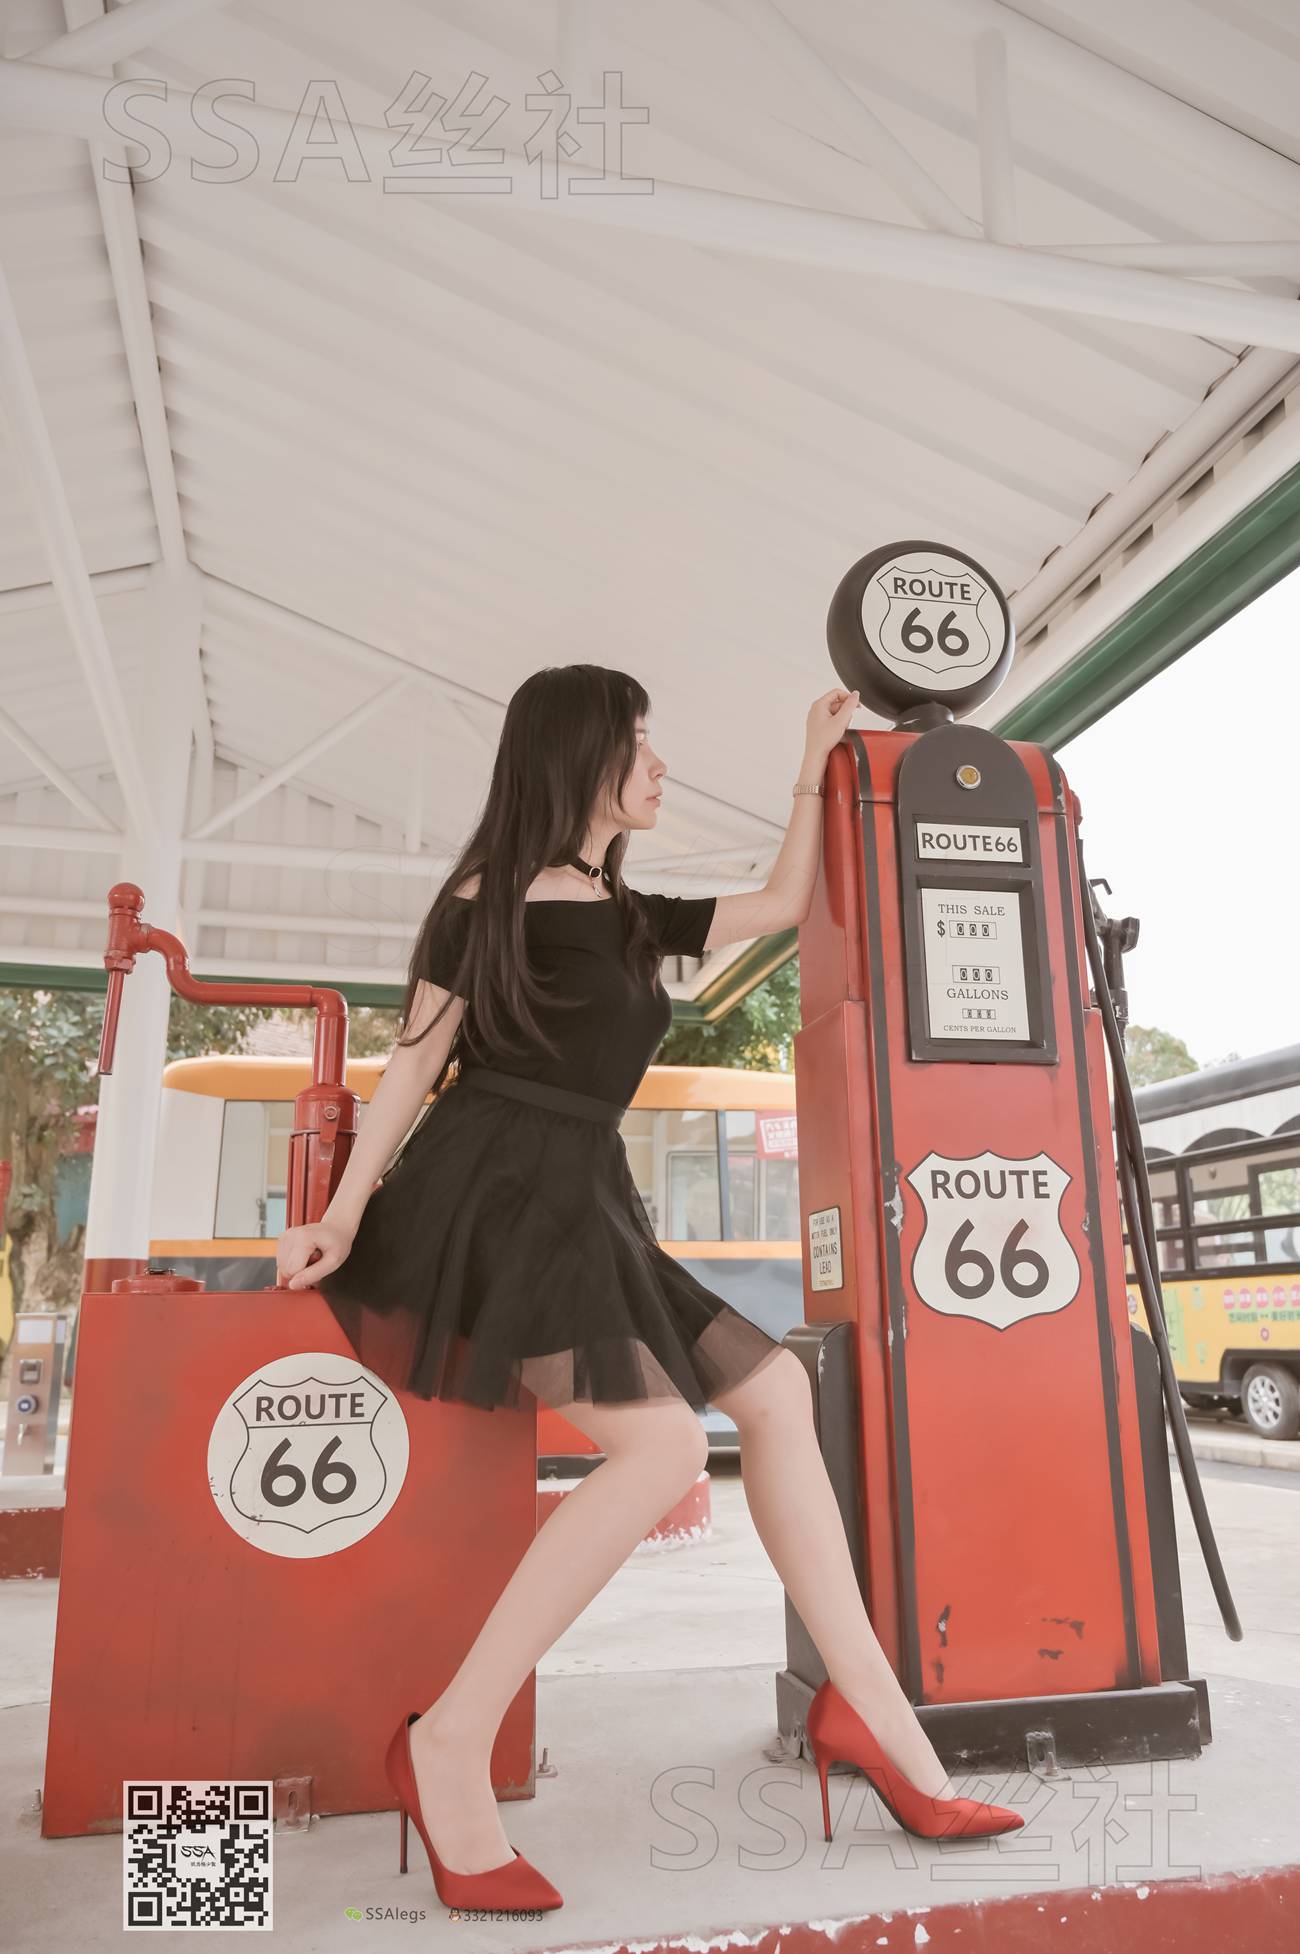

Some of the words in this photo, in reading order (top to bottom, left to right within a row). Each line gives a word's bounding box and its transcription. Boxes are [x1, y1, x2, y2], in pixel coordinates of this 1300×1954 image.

[893, 577, 972, 601] ROUTE
[901, 607, 970, 657] 66
[921, 832, 1018, 853] ROUTE66
[938, 904, 967, 915] THIS
[974, 905, 1006, 916] SALE
[946, 988, 1009, 1001] GALLONS
[970, 1025, 985, 1033] PER
[986, 1026, 1017, 1034] GALLON
[930, 1169, 1051, 1200] ROUTE
[813, 1241, 838, 1259] CONTAINS
[944, 1218, 1050, 1300] 66
[819, 1260, 832, 1275] LEAD
[255, 1392, 365, 1422] ROUTE
[260, 1435, 357, 1508] 66
